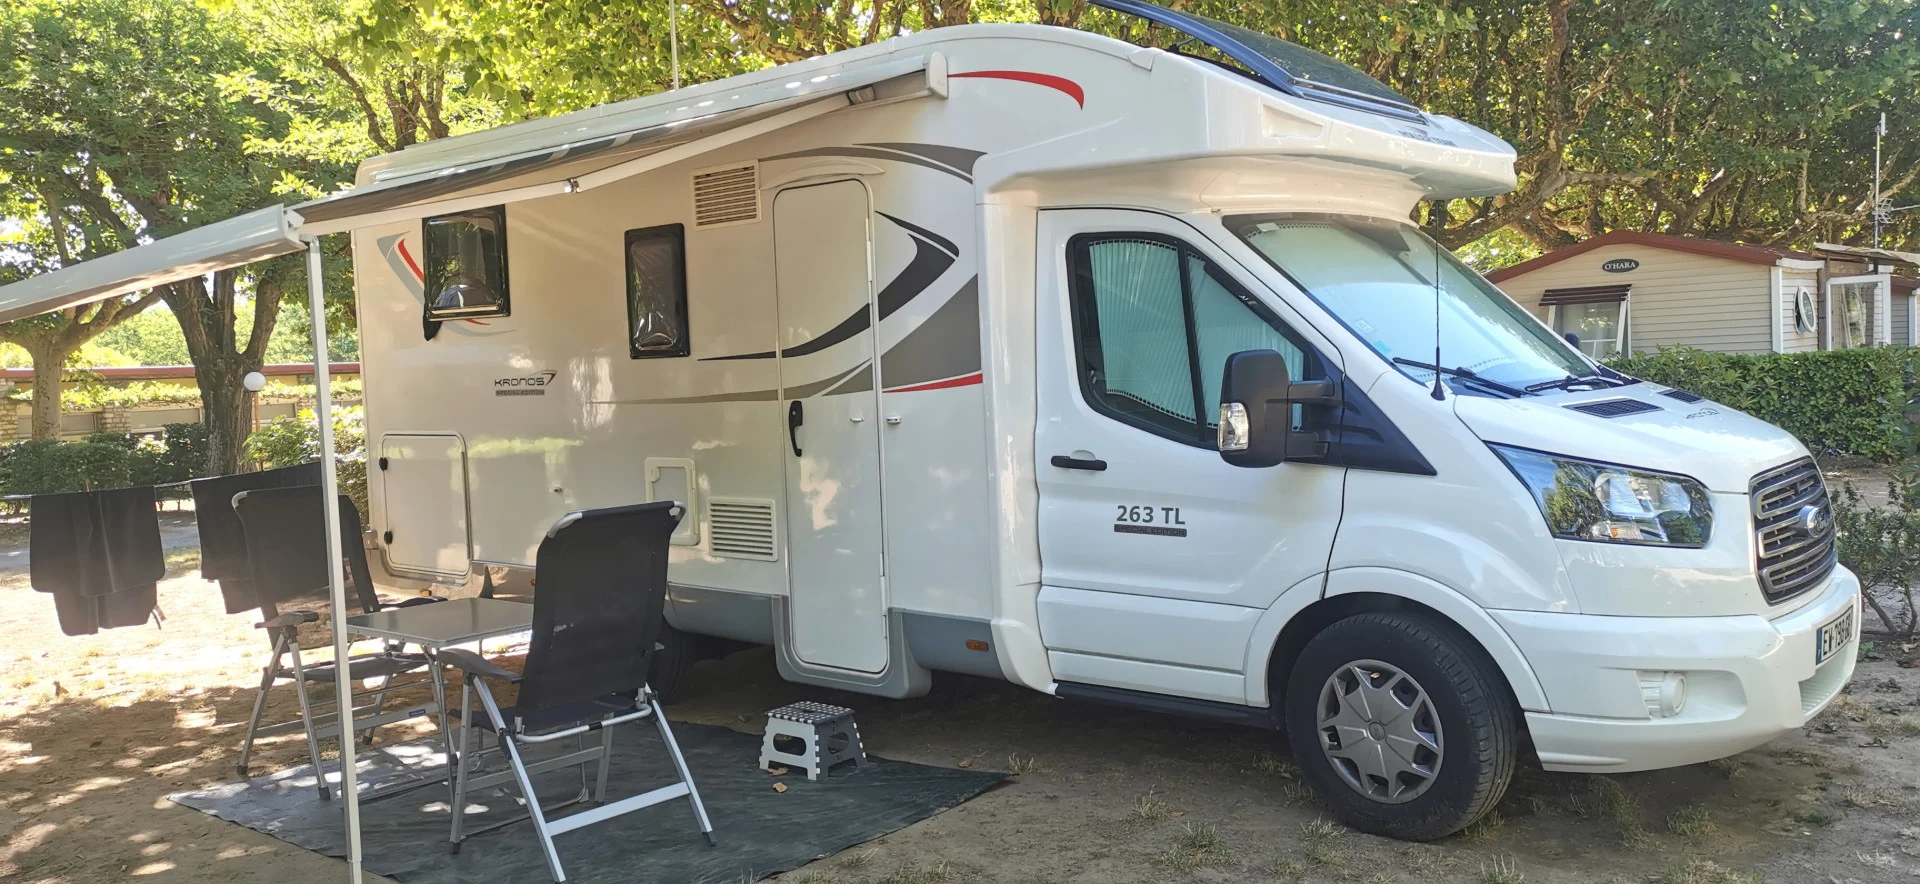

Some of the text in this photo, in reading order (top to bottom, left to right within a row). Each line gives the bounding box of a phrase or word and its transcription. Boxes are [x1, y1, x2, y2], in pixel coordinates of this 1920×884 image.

[1604, 261, 1636, 270] O'HARA
[494, 377, 545, 387] KRONOS
[1116, 505, 1186, 525] 263 TL
